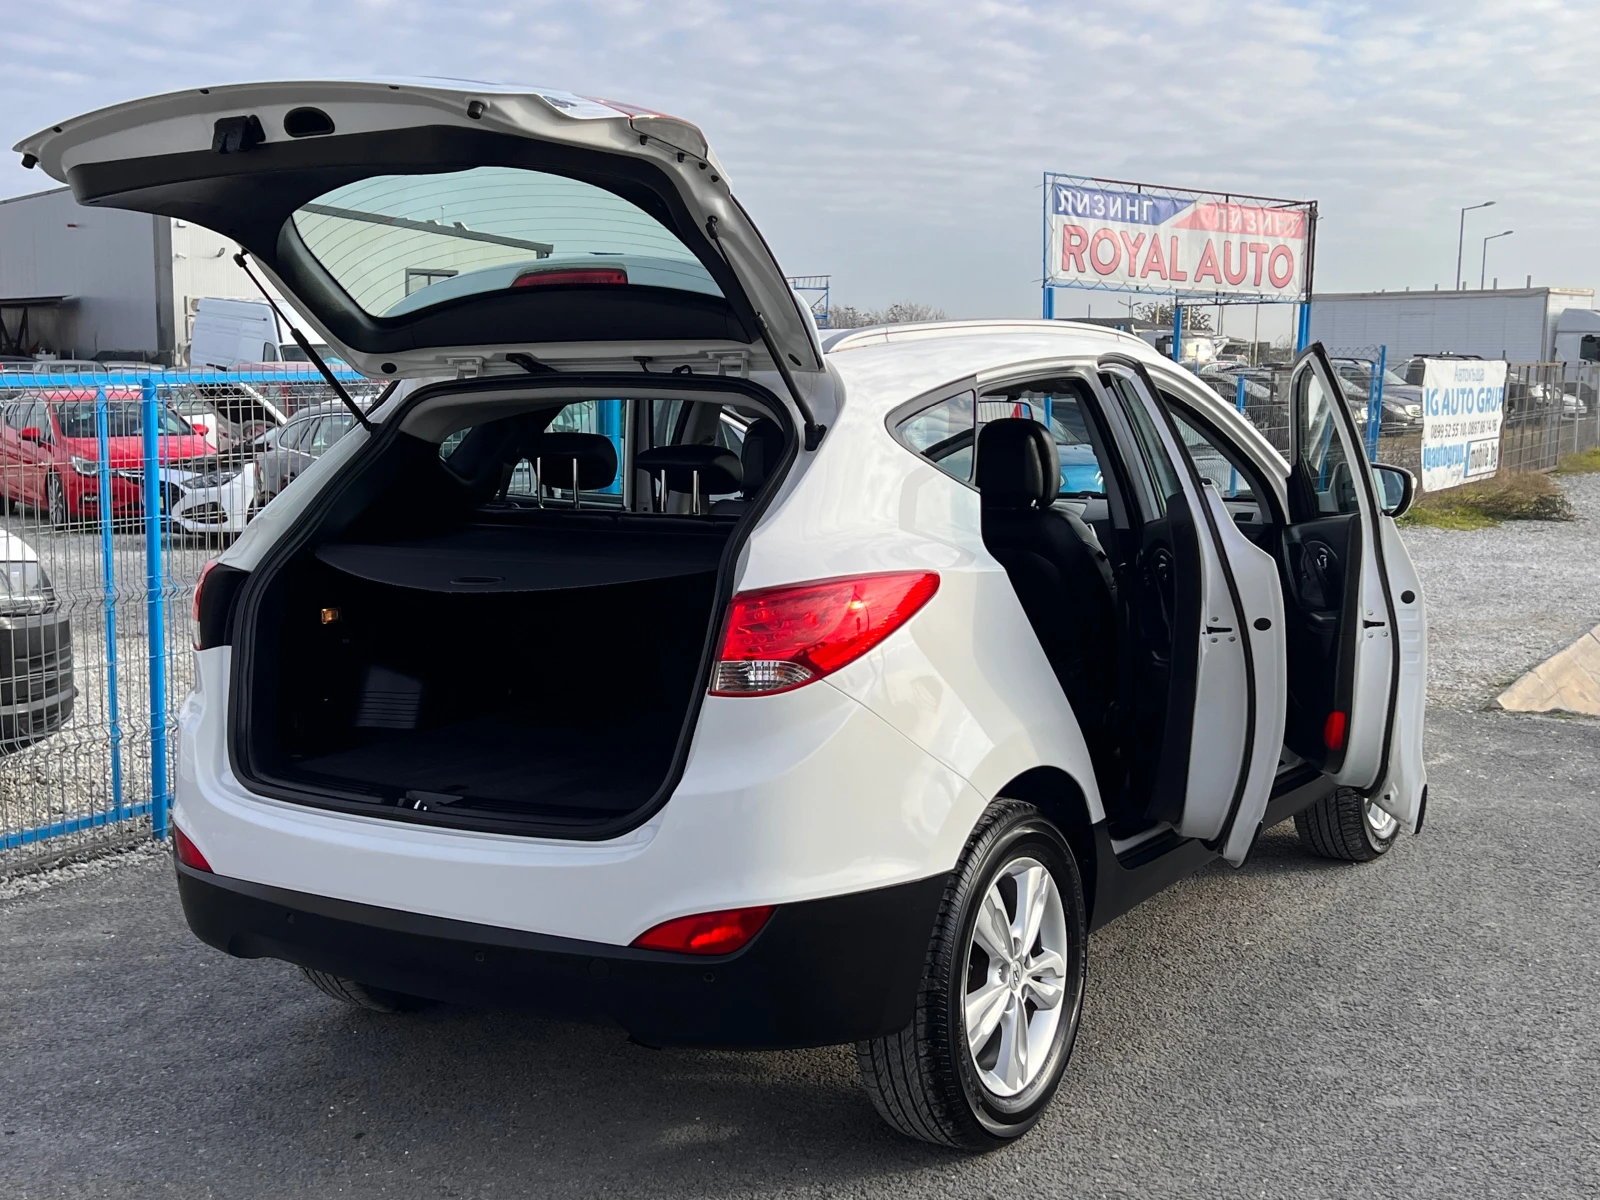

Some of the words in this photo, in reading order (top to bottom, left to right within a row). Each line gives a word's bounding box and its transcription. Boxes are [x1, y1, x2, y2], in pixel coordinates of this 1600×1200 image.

[1058, 190, 1154, 222] ЛИЗИНГ
[1061, 223, 1187, 282] ROYAL
[1194, 238, 1295, 289] AUTO
[1425, 387, 1439, 416] IG
[1441, 387, 1475, 416] AUTO
[1477, 386, 1504, 413] GRUP
[1452, 422, 1460, 437] 55
